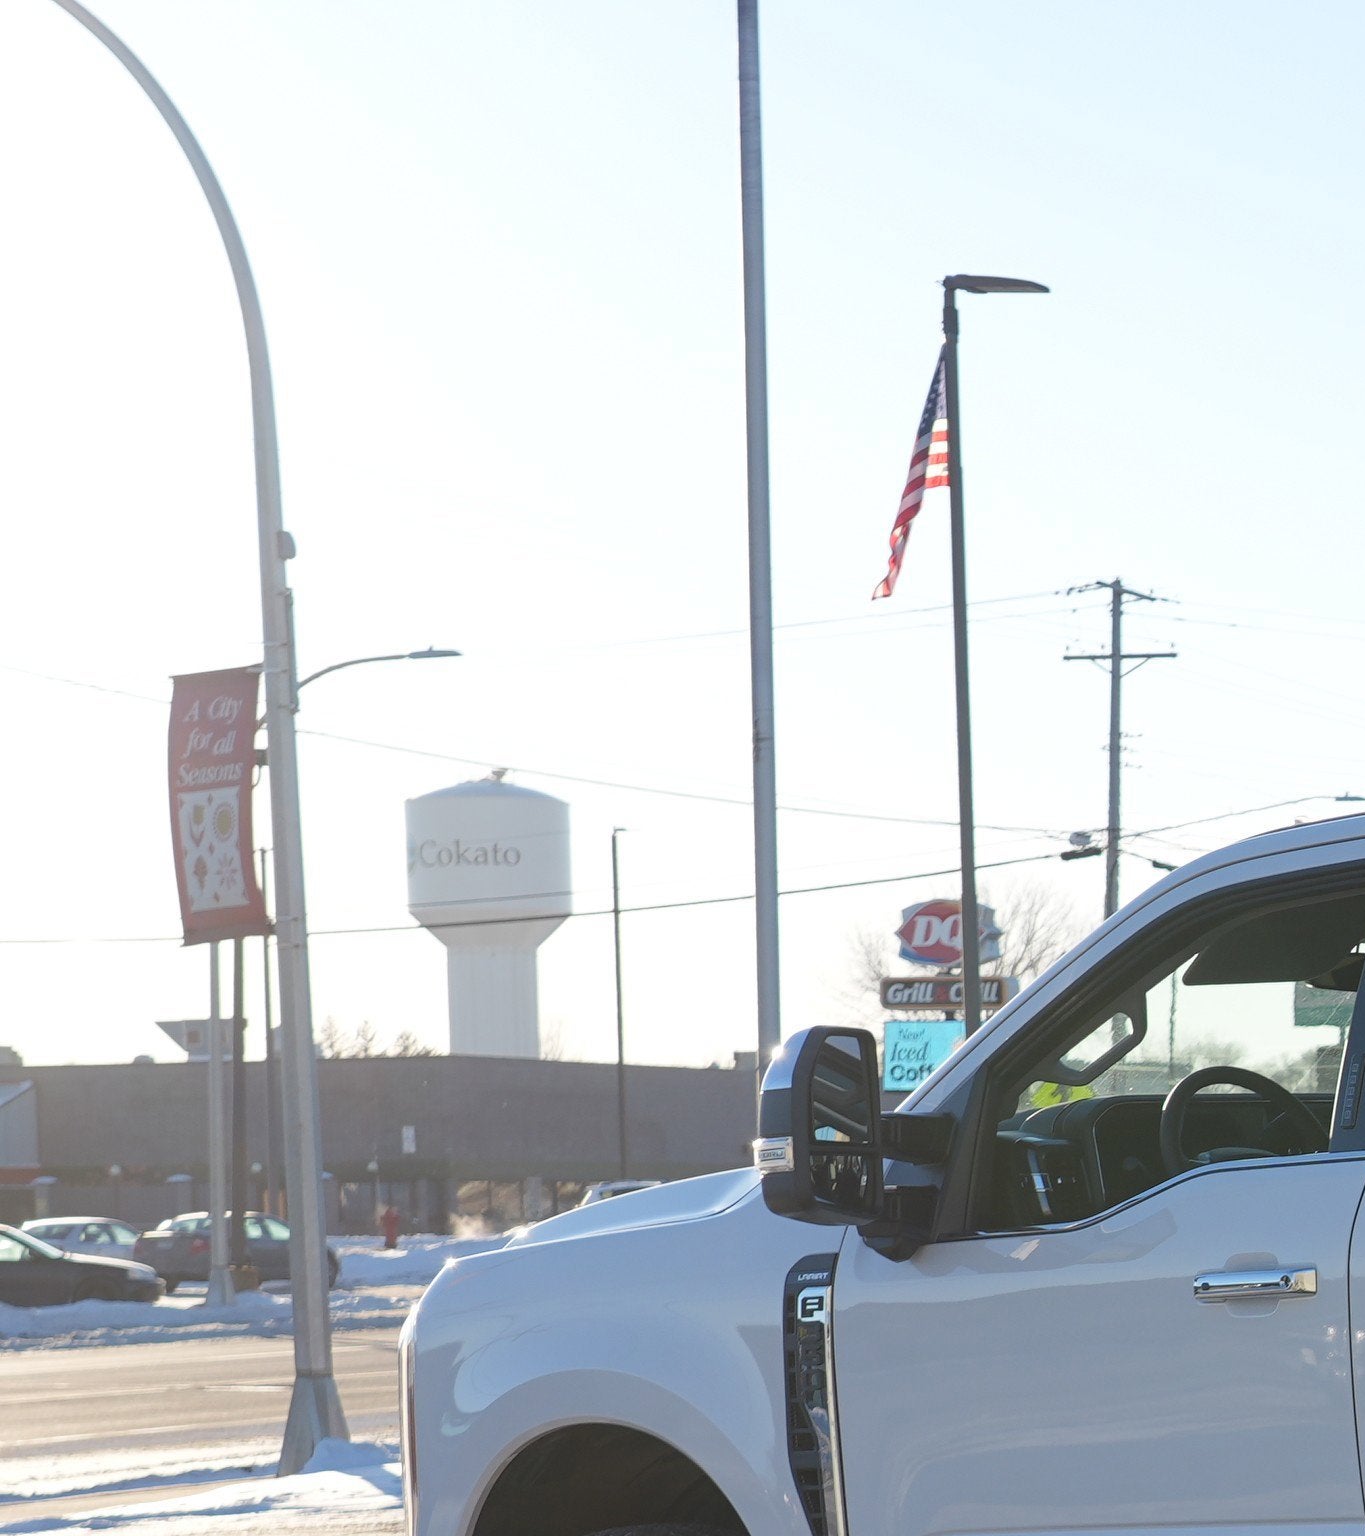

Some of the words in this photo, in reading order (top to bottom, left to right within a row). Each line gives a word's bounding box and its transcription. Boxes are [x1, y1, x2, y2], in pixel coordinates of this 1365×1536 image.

[183, 699, 201, 722] A
[208, 695, 244, 725] City
[182, 728, 214, 759] for
[213, 730, 237, 755] all
[178, 762, 244, 786] Seasons
[420, 838, 521, 868] Cokato
[912, 913, 963, 949] DQ
[886, 981, 934, 1003] Grill
[949, 981, 999, 1003] Cill
[890, 1041, 930, 1062] Iced
[797, 1272, 829, 1281] LARIAT
